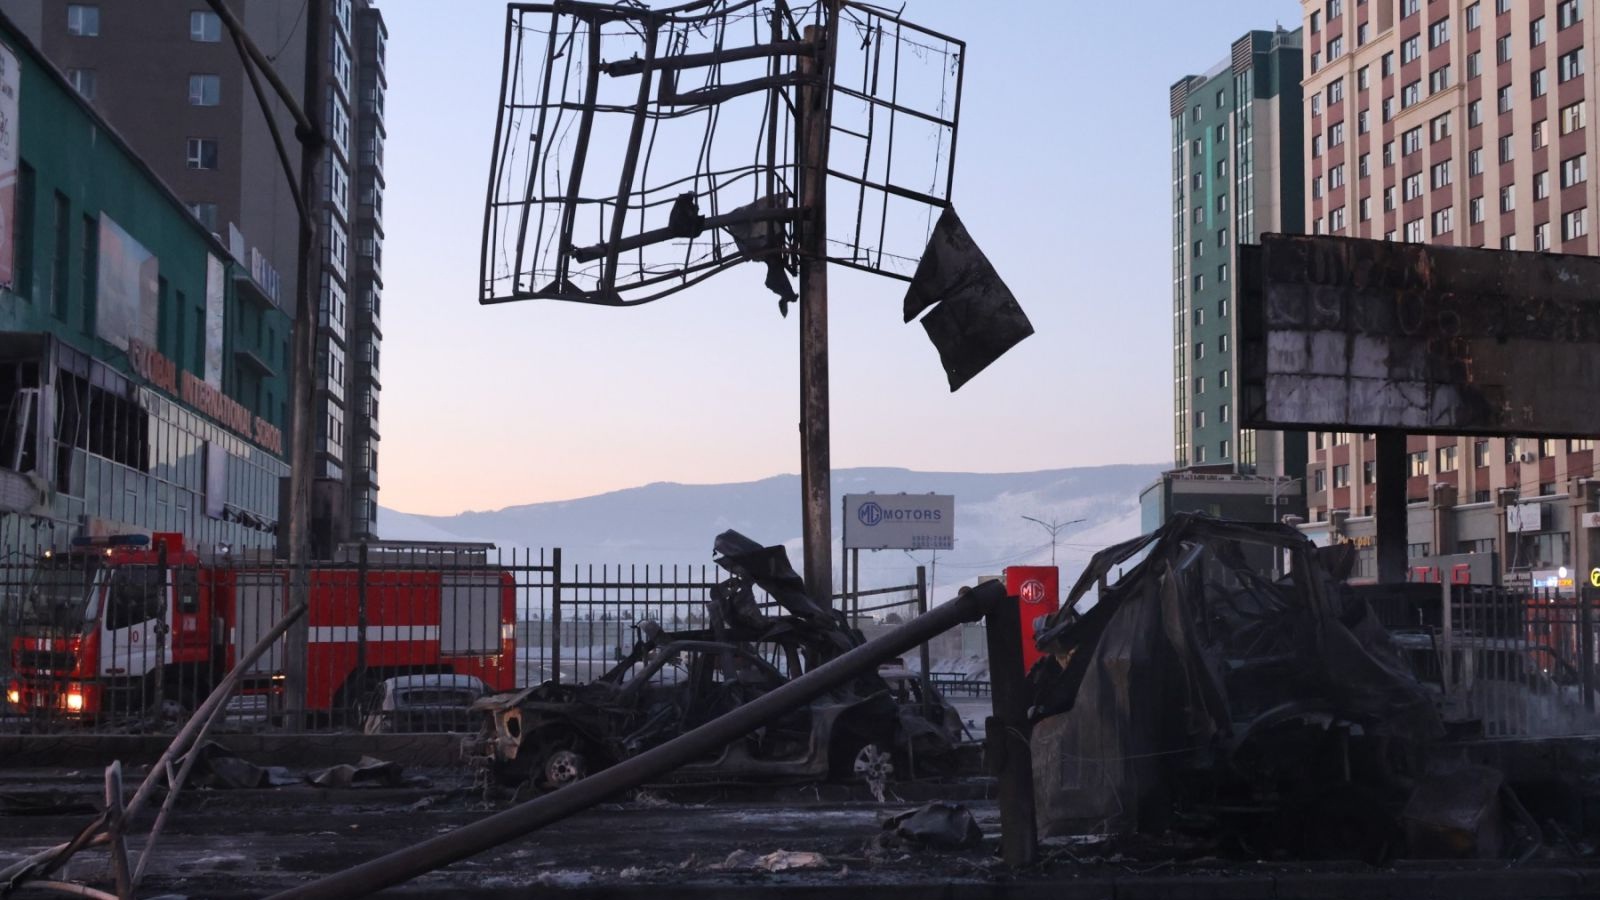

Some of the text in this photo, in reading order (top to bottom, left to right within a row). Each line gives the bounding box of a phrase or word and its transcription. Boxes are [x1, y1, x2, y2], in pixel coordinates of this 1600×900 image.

[129, 338, 283, 456] GLOBAL INTERNATIONAL SCHOOL
[860, 504, 942, 524] MG MOTORS
[1021, 581, 1043, 602] MG
